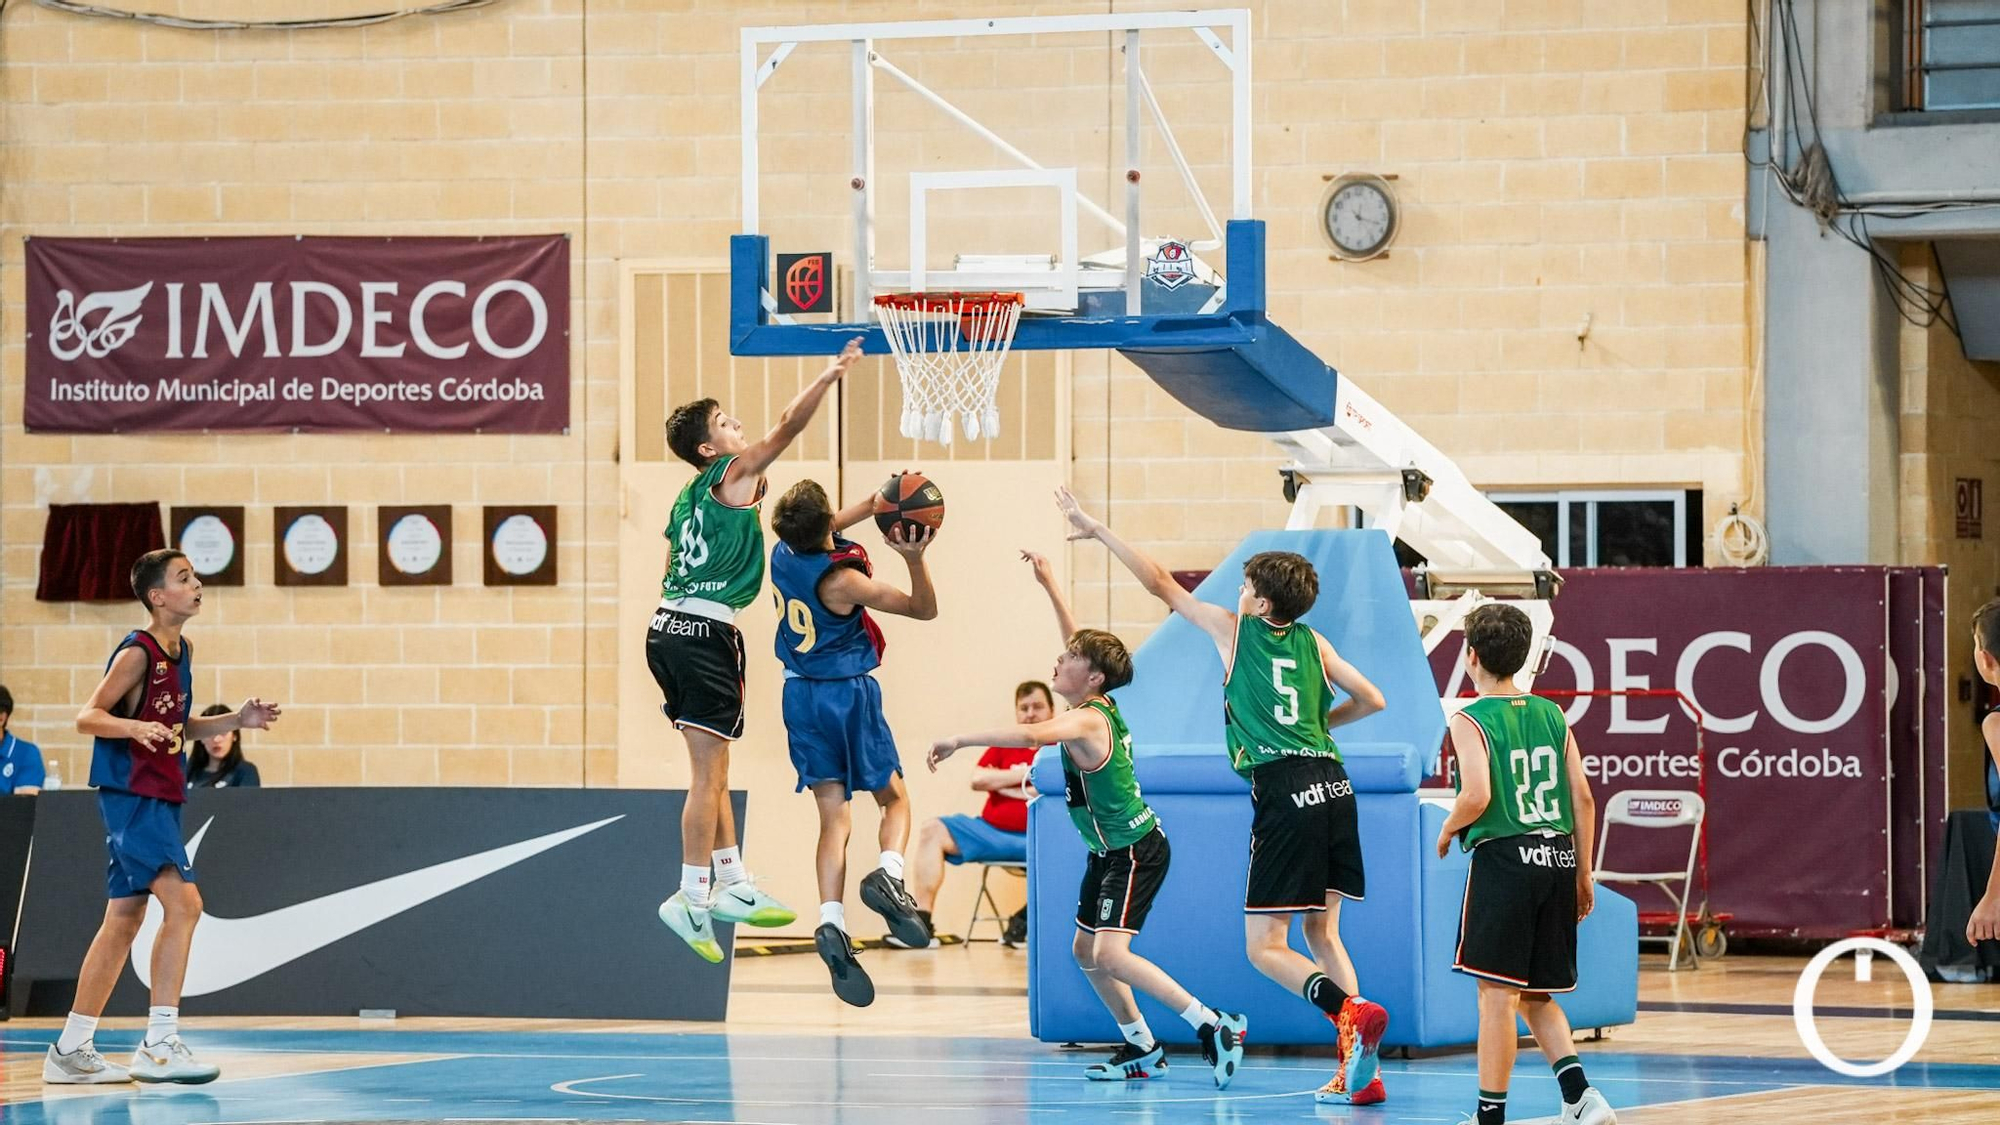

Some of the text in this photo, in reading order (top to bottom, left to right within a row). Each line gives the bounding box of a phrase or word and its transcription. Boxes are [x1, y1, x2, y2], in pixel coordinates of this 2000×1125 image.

[165, 279, 548, 359] IMDECO
[50, 377, 544, 406] Instituto Municipal de Deportes Córdoba
[1271, 658, 1299, 726] 5
[1444, 630, 1867, 734] DECO
[1581, 747, 1862, 784] eportes Córdoba
[1324, 779, 1354, 798] tea
[1510, 745, 1562, 824] 22
[1640, 801, 1682, 811] IMDECO
[1552, 846, 1577, 868] tea
